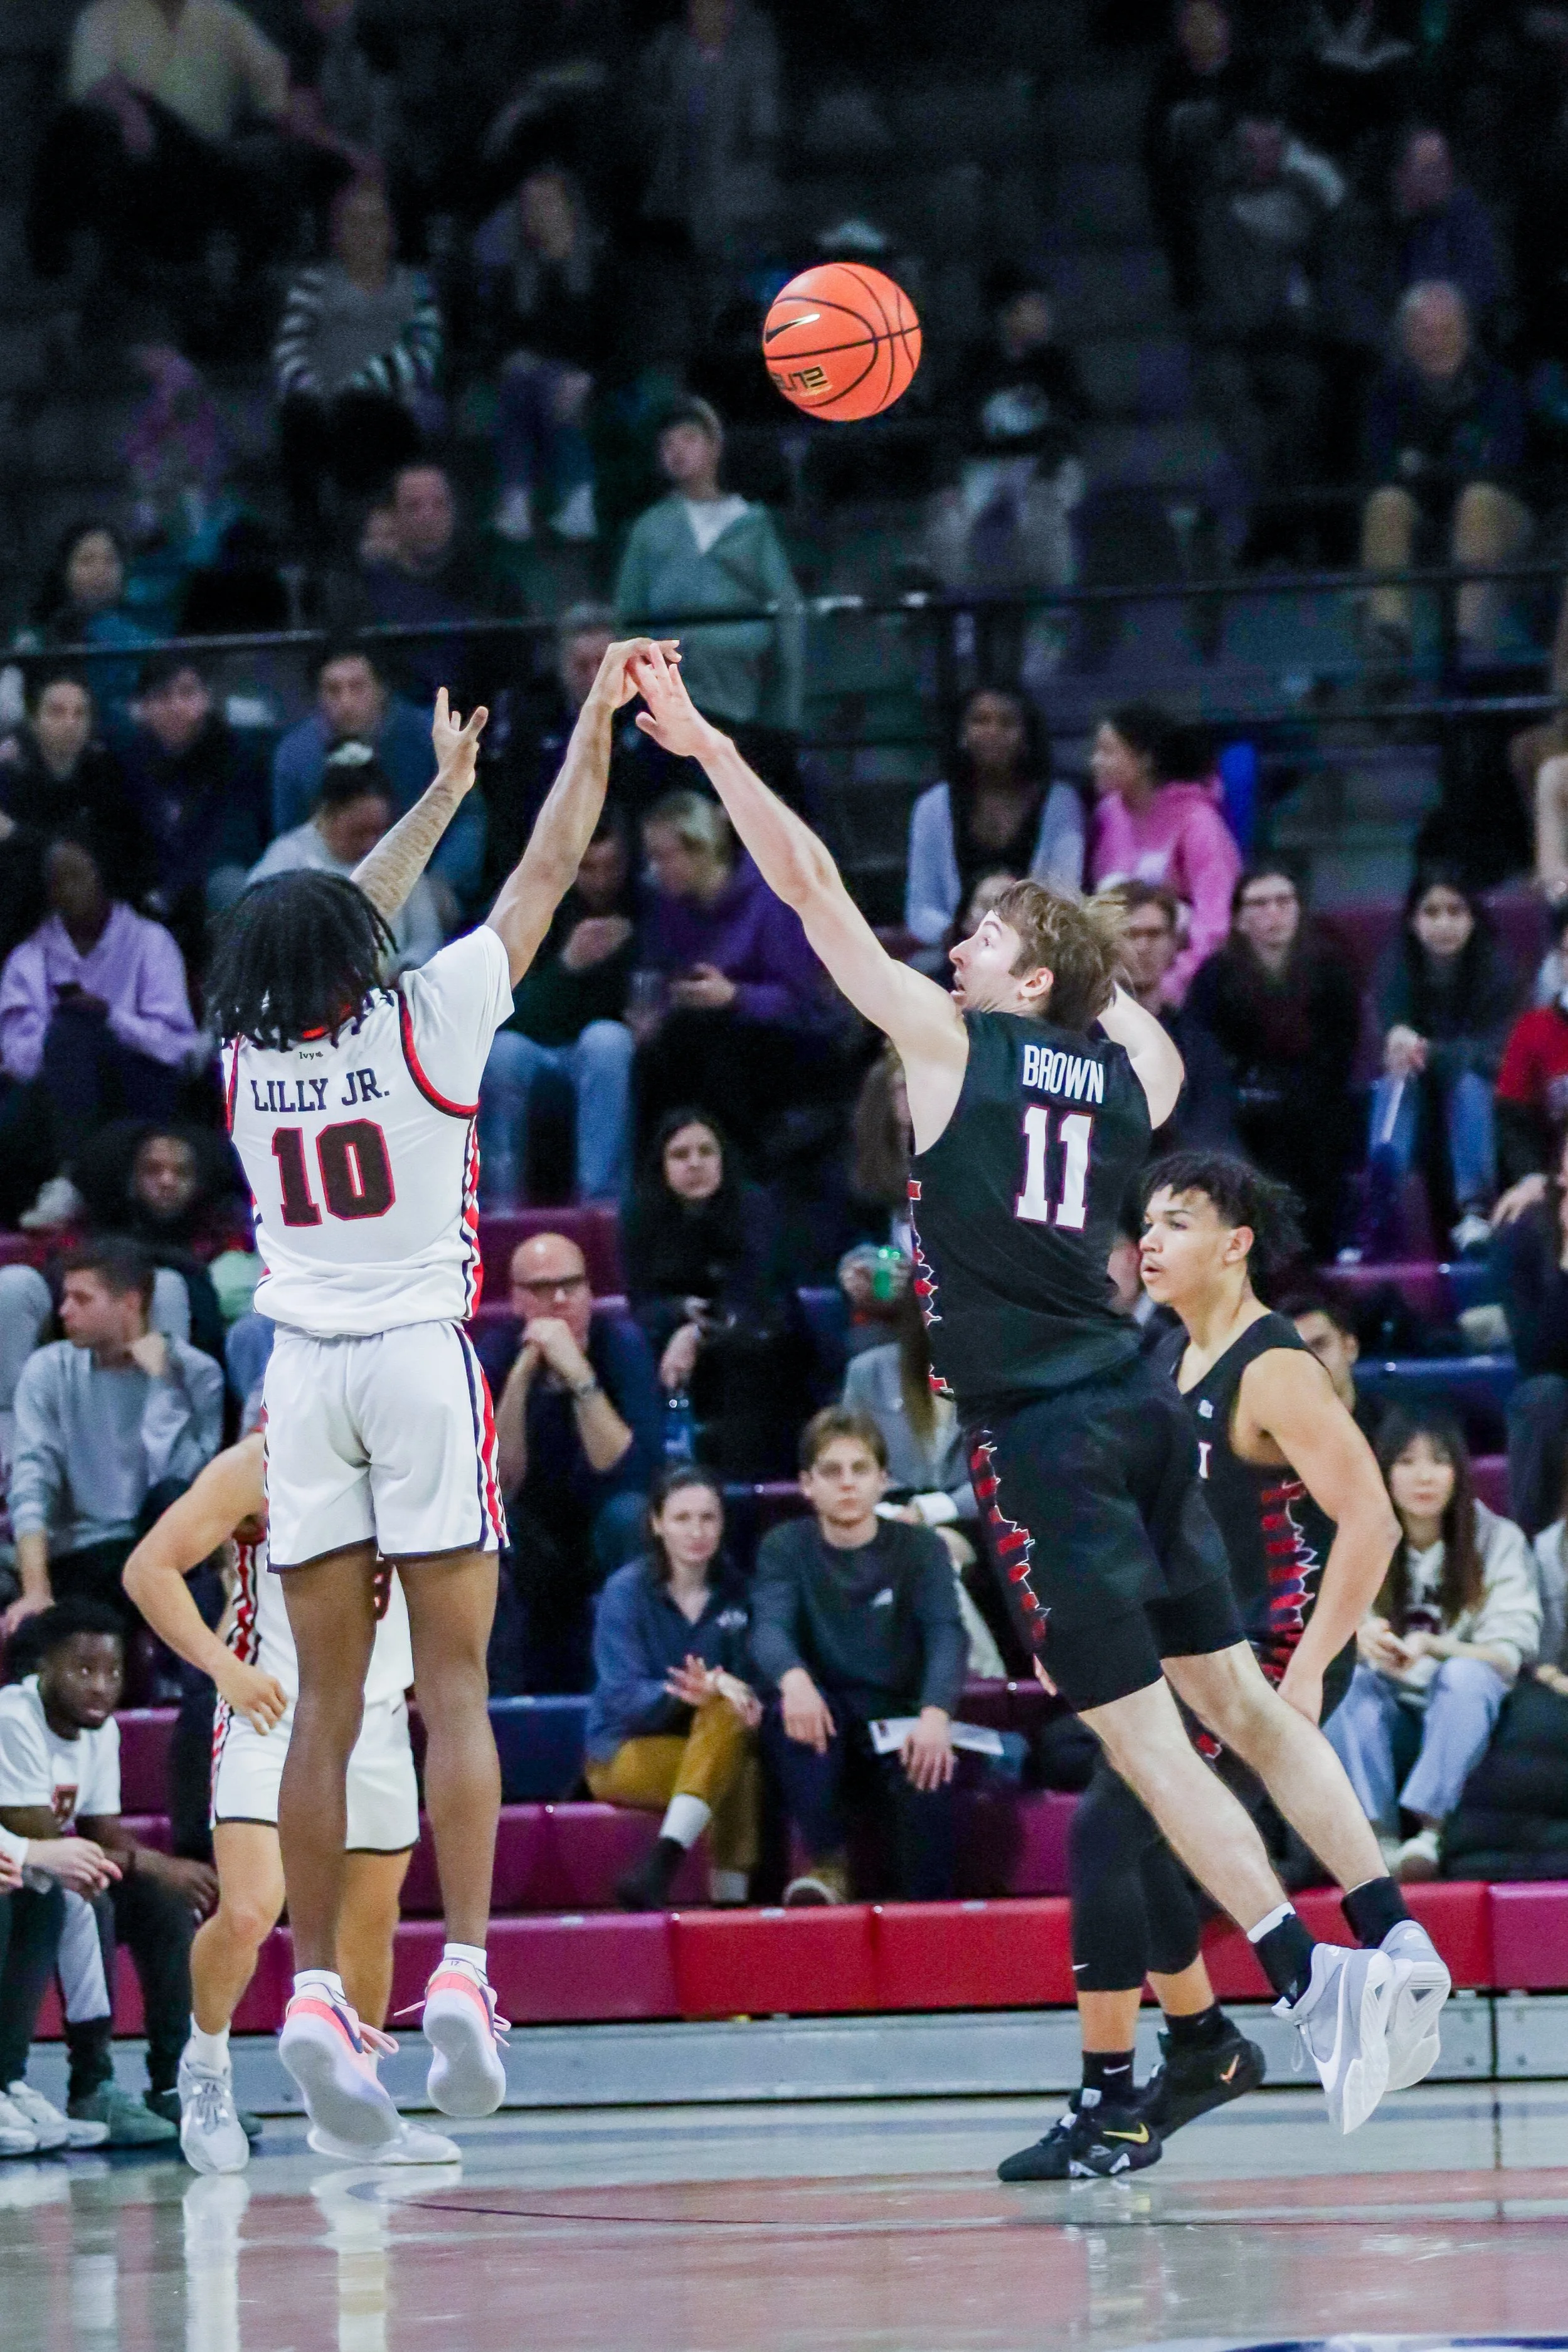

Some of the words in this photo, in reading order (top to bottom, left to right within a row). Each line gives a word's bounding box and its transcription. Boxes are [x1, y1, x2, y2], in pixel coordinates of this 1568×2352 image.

[299, 1051, 314, 1061] Ivy
[1022, 1044, 1104, 1104] BROWN
[250, 1078, 329, 1113] LILLY
[341, 1067, 391, 1106] JR.
[271, 1118, 396, 1227] 10
[1014, 1104, 1094, 1232] 11
